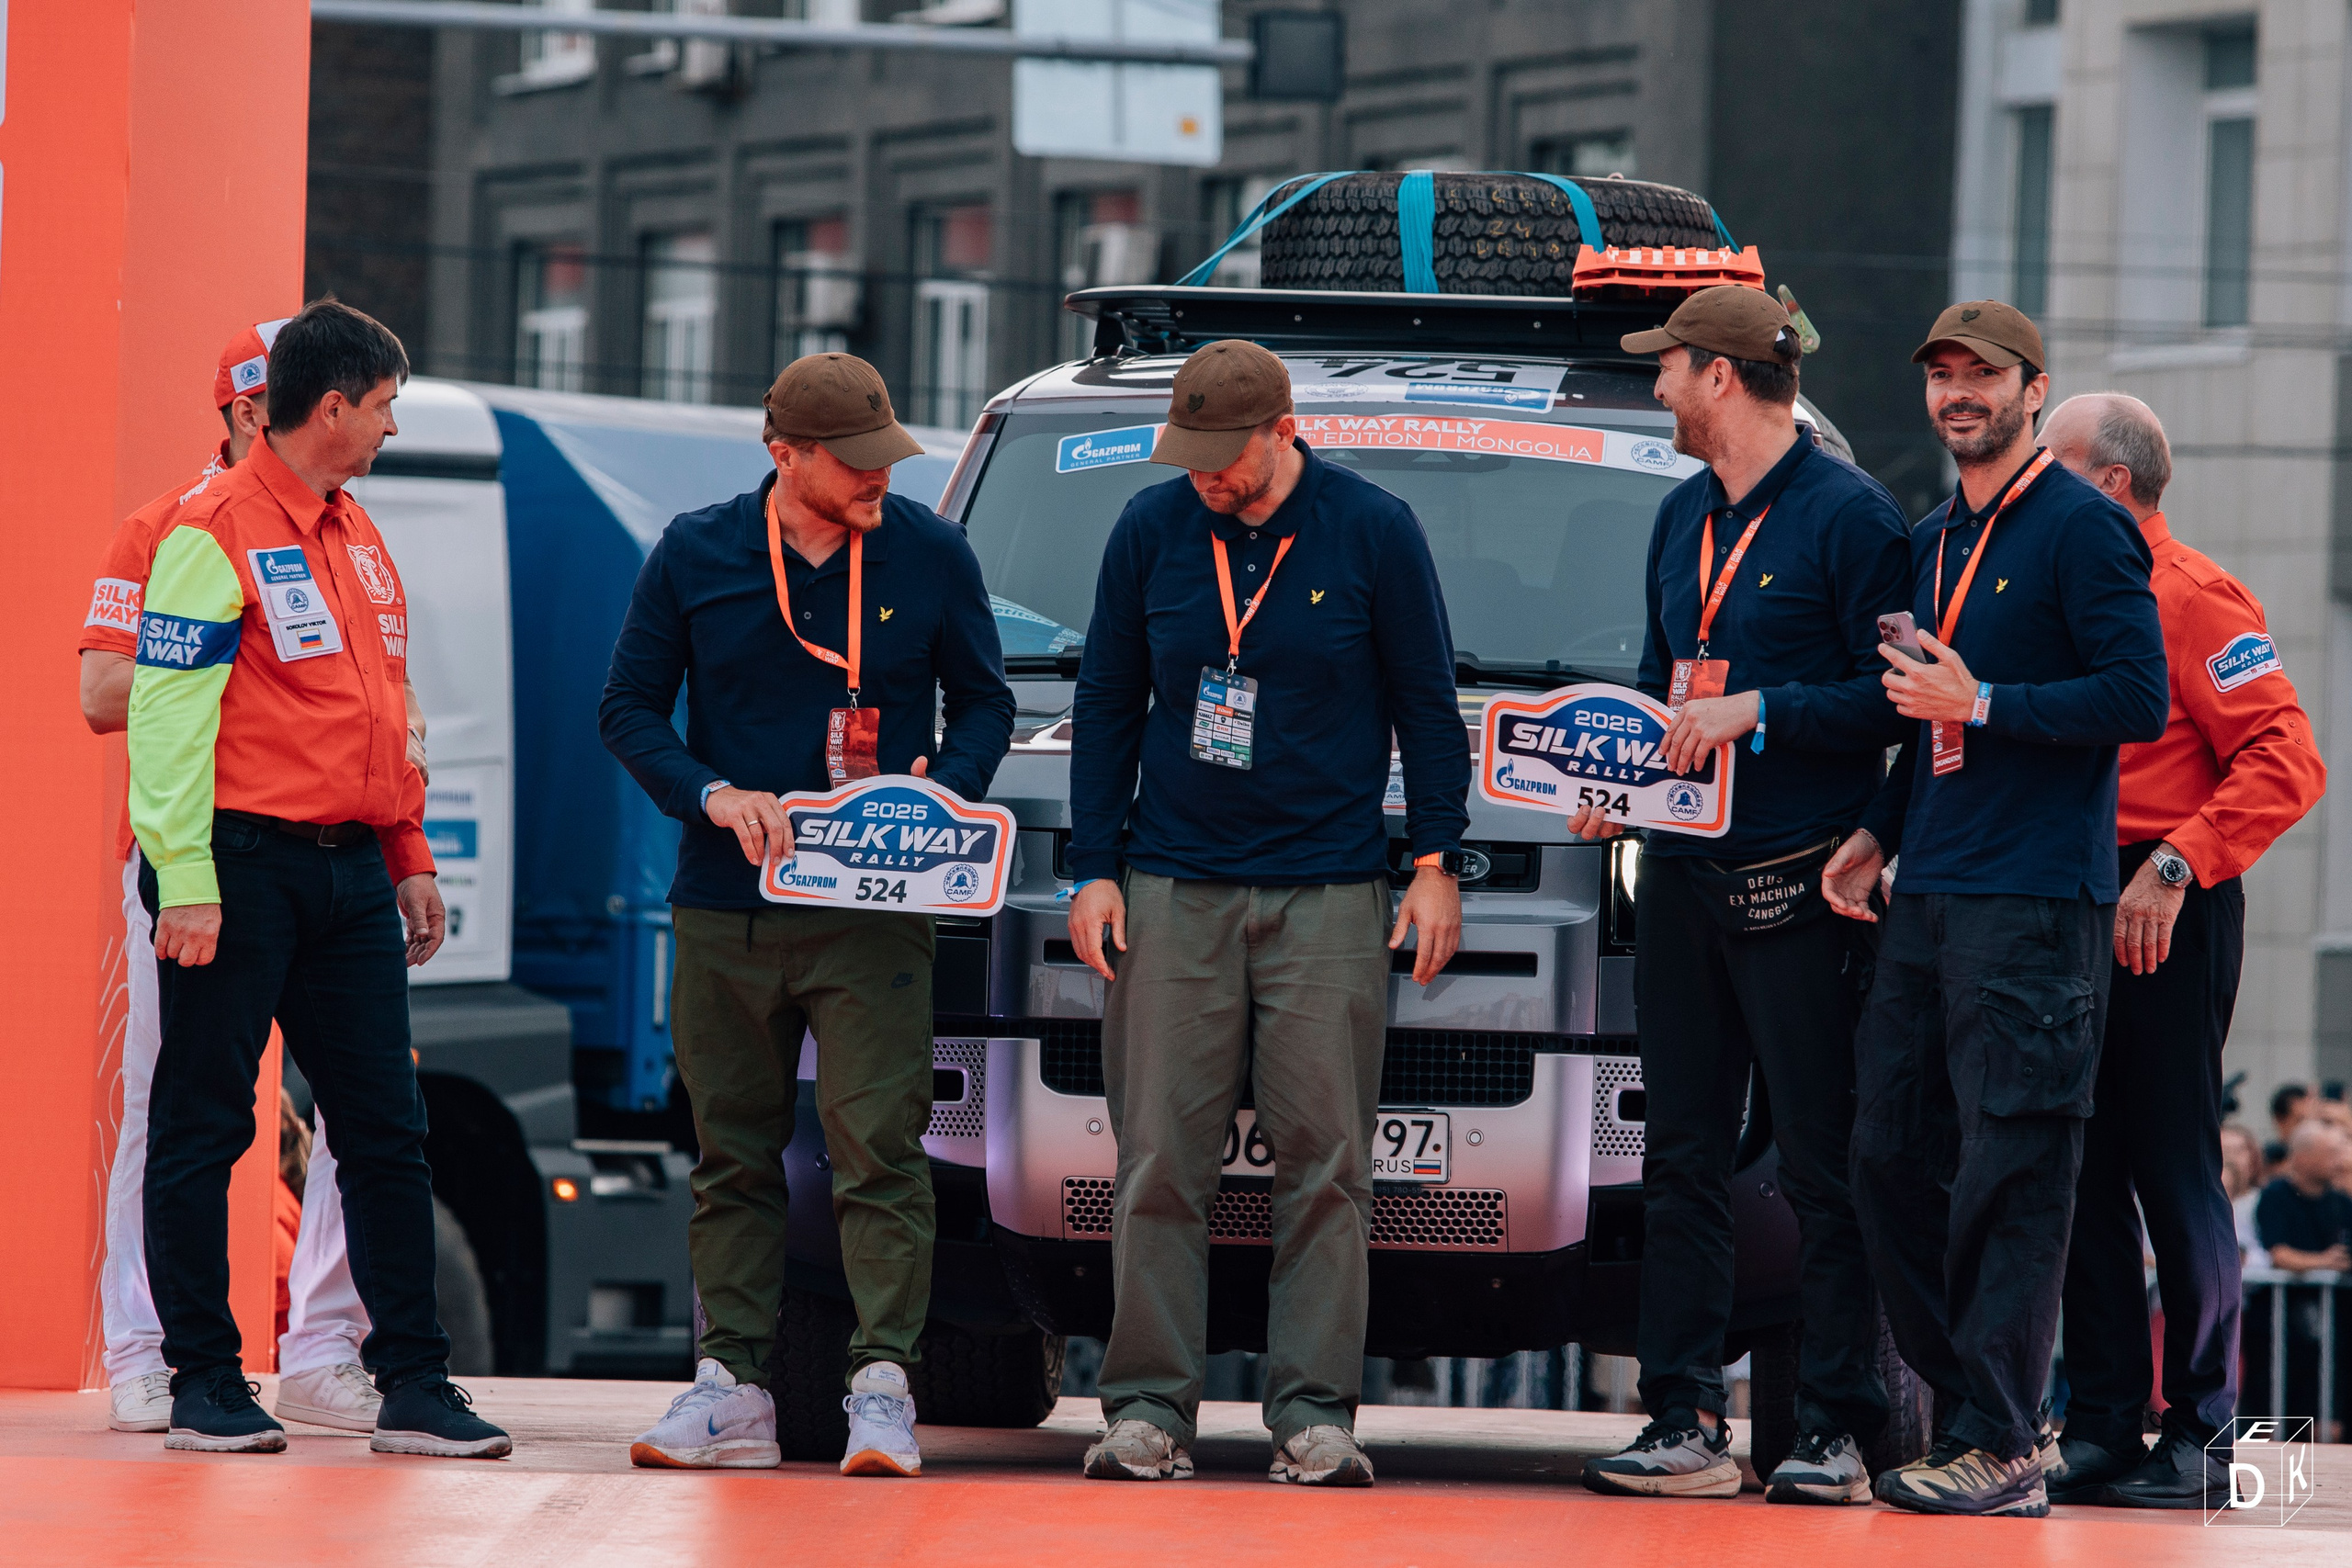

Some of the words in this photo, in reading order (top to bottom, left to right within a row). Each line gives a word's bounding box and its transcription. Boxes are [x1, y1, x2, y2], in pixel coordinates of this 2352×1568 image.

[1295, 419, 1330, 431] LK
[1338, 418, 1396, 431] WAY
[1404, 419, 1486, 434] RALLY
[1091, 443, 1141, 458] GAZPROM
[1295, 432, 1317, 440] th
[1323, 432, 1422, 446] EDITION
[1457, 435, 1592, 460] MONGOLIA
[1070, 458, 1102, 468] GENERAL
[1106, 453, 1140, 461] PARTNER
[278, 563, 304, 574] GAZPROM
[96, 584, 140, 606] SILK
[93, 603, 139, 626] WAY
[145, 618, 205, 646] SILK
[145, 639, 202, 665] WAY
[2217, 649, 2252, 674] SILK
[2251, 643, 2271, 657] WAY
[1574, 709, 1643, 734] 2025
[830, 738, 844, 746] WAY
[1508, 722, 1611, 762] SILK
[1566, 760, 1645, 782] RALLY
[1514, 778, 1556, 796] GAZPROM
[862, 801, 929, 820] 2025
[1577, 786, 1631, 817] 524
[794, 818, 896, 851] SILK
[899, 826, 988, 855] WAY
[849, 852, 925, 867] RALLY
[796, 875, 837, 889] GAZPROM
[854, 876, 908, 903] 524
[1729, 895, 1746, 906] EX
[1749, 883, 1805, 904] MACHINA
[1747, 902, 1789, 919] CANGGU
[1374, 1119, 1434, 1157] 97
[1373, 1159, 1411, 1173] RUS
